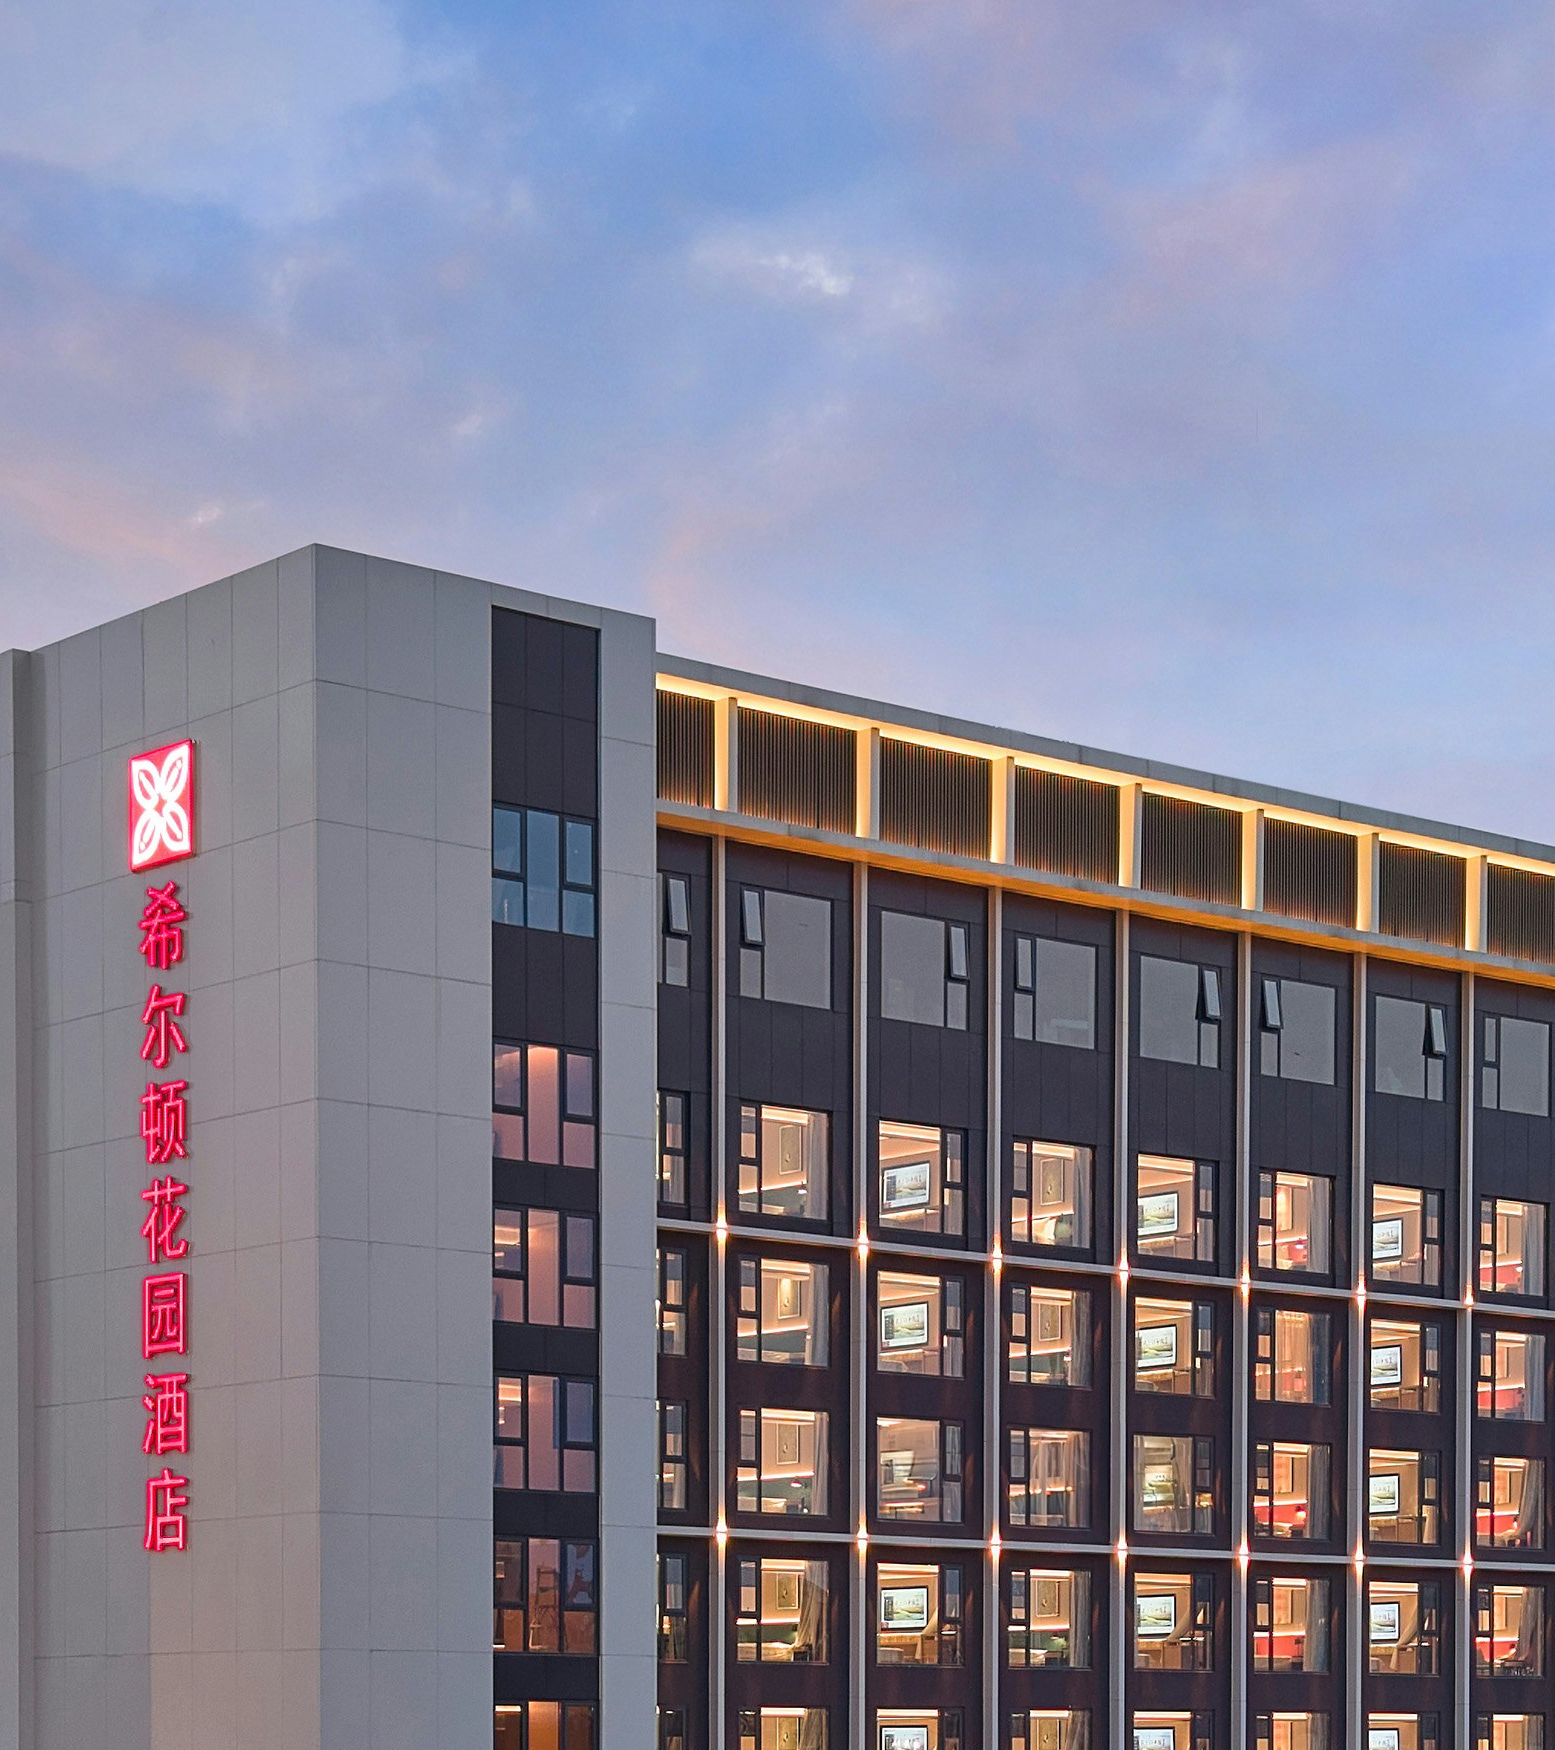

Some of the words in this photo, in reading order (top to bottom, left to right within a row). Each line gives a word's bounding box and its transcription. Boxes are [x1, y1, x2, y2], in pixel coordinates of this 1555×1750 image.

[139, 881, 190, 1552] 希尔顿花园酒店
